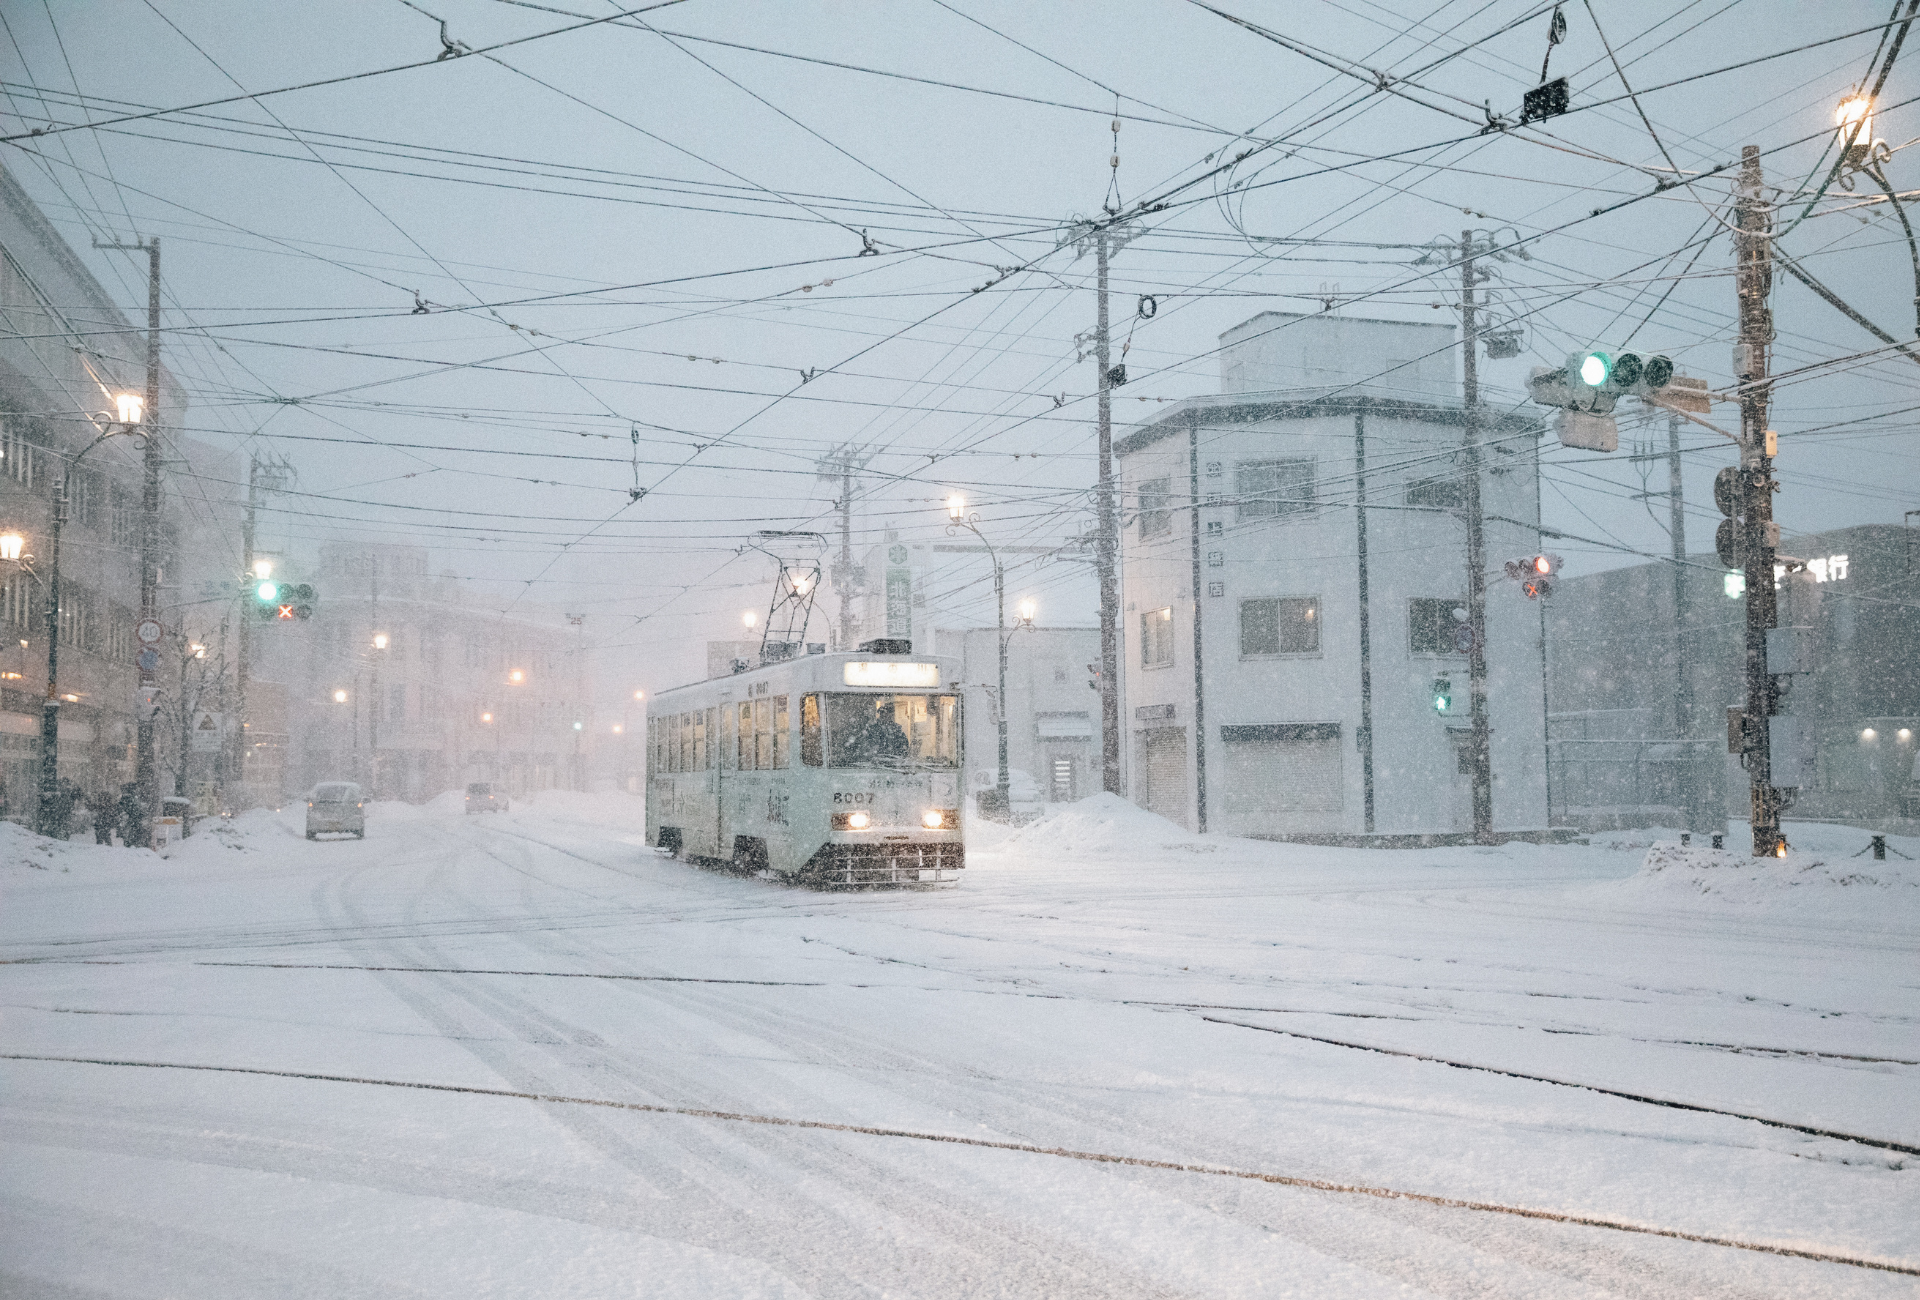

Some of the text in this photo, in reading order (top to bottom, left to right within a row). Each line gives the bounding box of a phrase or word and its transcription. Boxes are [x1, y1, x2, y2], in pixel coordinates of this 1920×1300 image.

[890, 580, 909, 634] 北海道
[141, 626, 158, 638] 40
